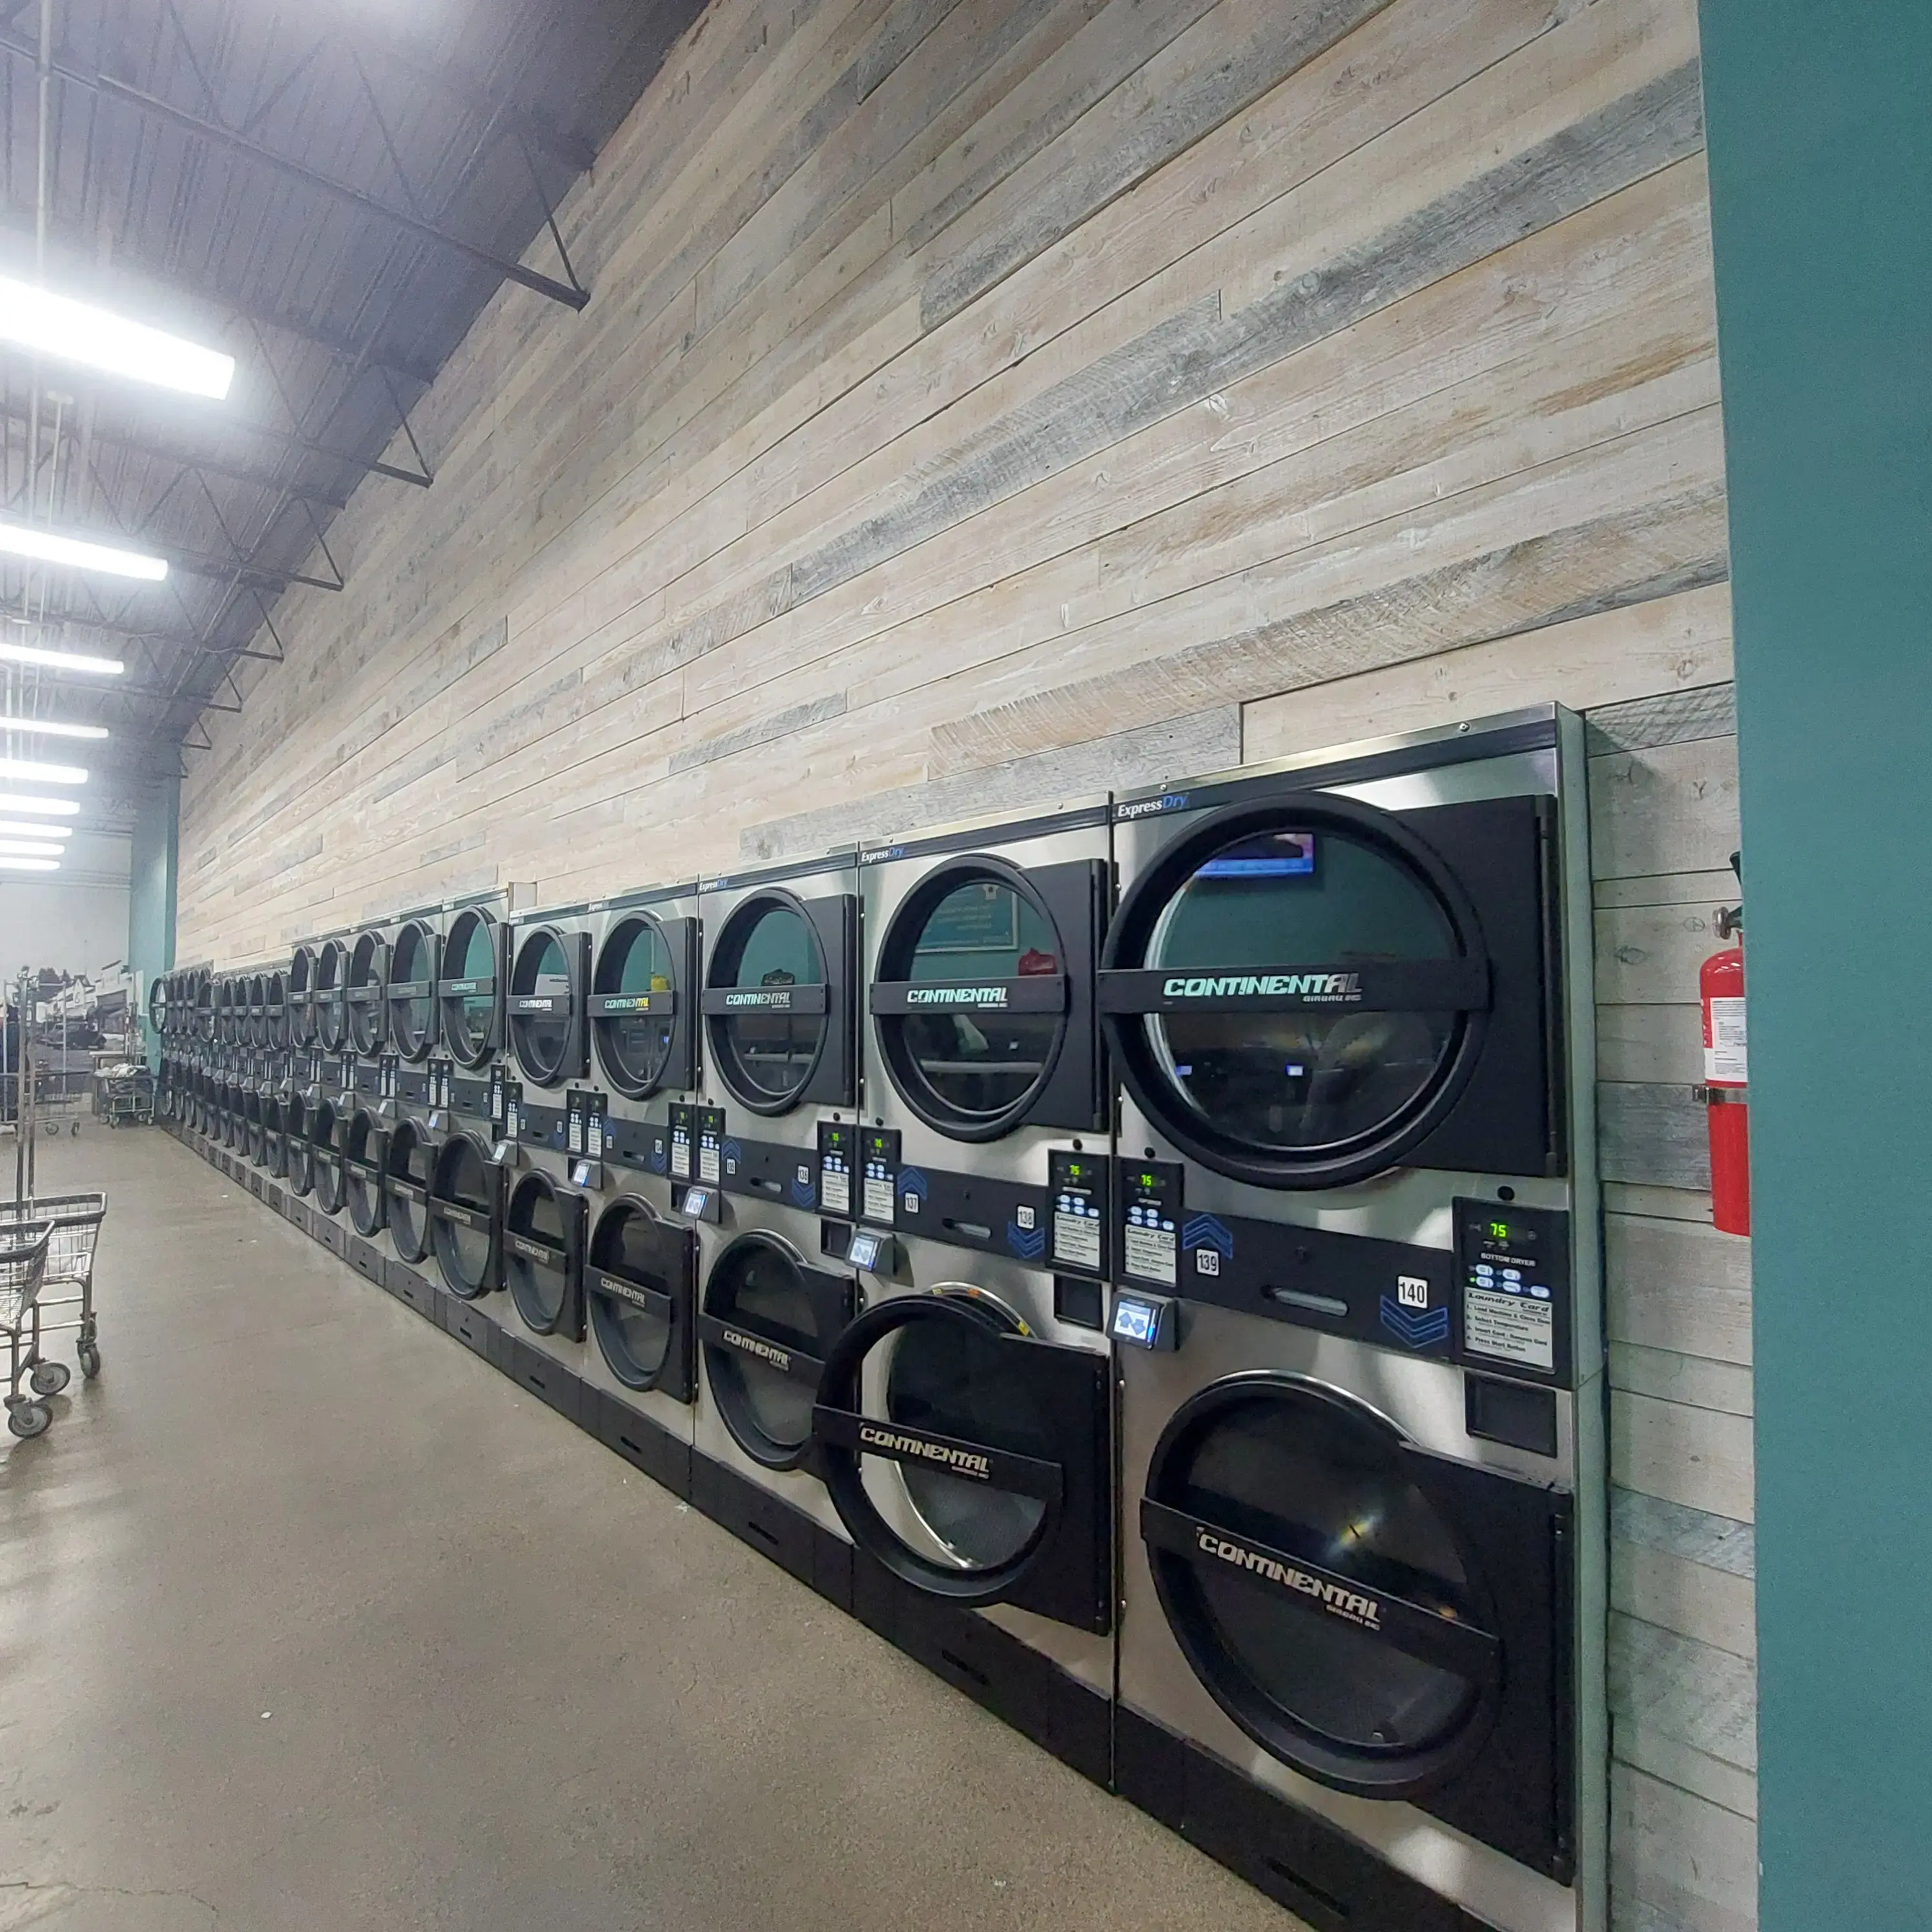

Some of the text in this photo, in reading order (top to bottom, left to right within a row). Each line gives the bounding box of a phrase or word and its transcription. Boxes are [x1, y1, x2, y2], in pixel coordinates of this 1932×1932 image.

[1118, 796, 1187, 819] ExpressDry
[861, 847, 904, 863] ExpressDry
[1163, 973, 1362, 996] CONTINENTAL
[726, 992, 790, 1005] CONTINENTAL
[907, 987, 1008, 1003] CONTINENTAL
[1141, 1175, 1152, 1186] 75
[906, 1197, 917, 1209] 137
[1019, 1211, 1032, 1225] 138
[1490, 1223, 1507, 1237] 75
[1198, 1254, 1217, 1271] 139
[1481, 1252, 1536, 1267] BOTTOM DRYER
[1399, 1282, 1424, 1304] 140
[1468, 1292, 1549, 1312] Laundry Card
[723, 1330, 788, 1365] CONTINENTAL
[860, 1427, 989, 1473] CONTINENTAL
[1199, 1534, 1381, 1623] CONTINENTAL
